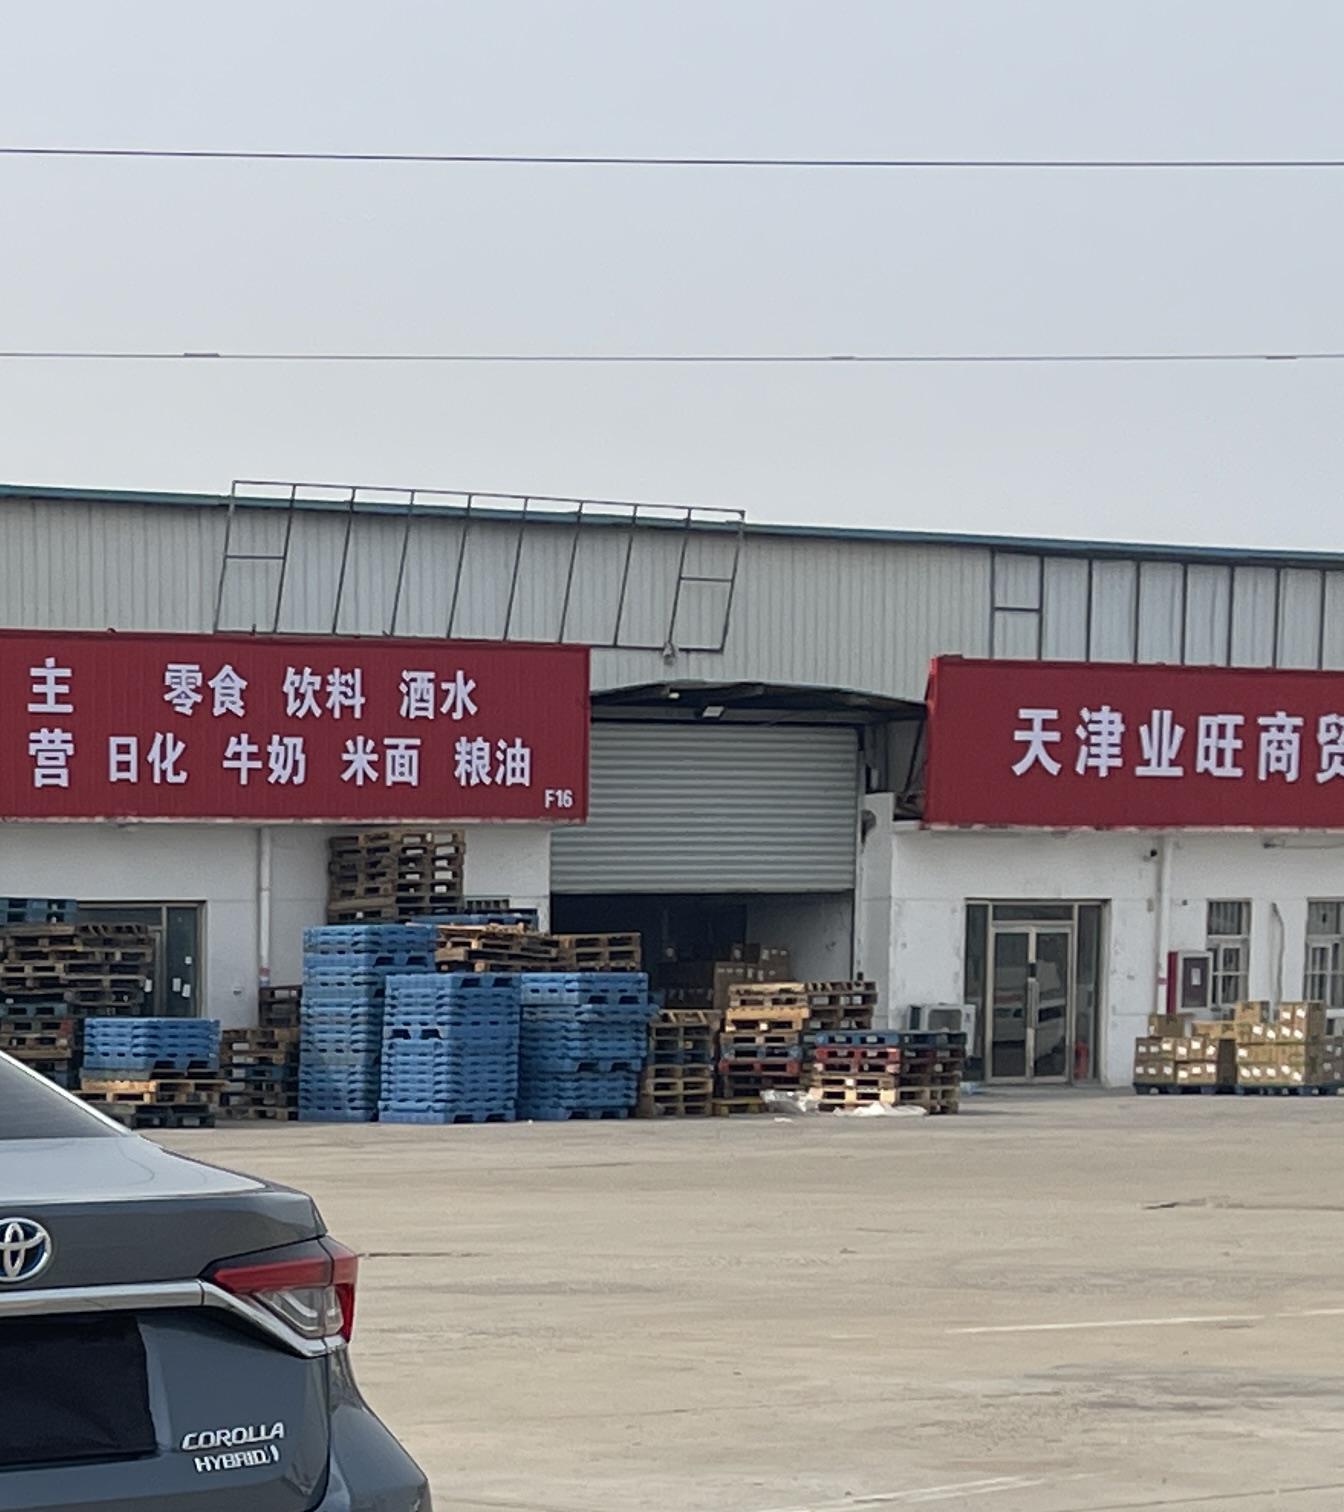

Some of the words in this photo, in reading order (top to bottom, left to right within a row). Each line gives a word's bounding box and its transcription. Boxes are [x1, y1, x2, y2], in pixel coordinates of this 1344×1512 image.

[163, 663, 248, 717] 零食
[282, 666, 366, 719] 饮料
[399, 669, 478, 720] 酒水
[27, 656, 75, 788] 主营
[109, 732, 188, 784] 日化
[222, 733, 306, 785] 牛奶
[341, 735, 421, 786] 米面
[454, 736, 531, 787] 粮油
[545, 789, 573, 808] F16
[182, 1421, 285, 1450] COROLLA
